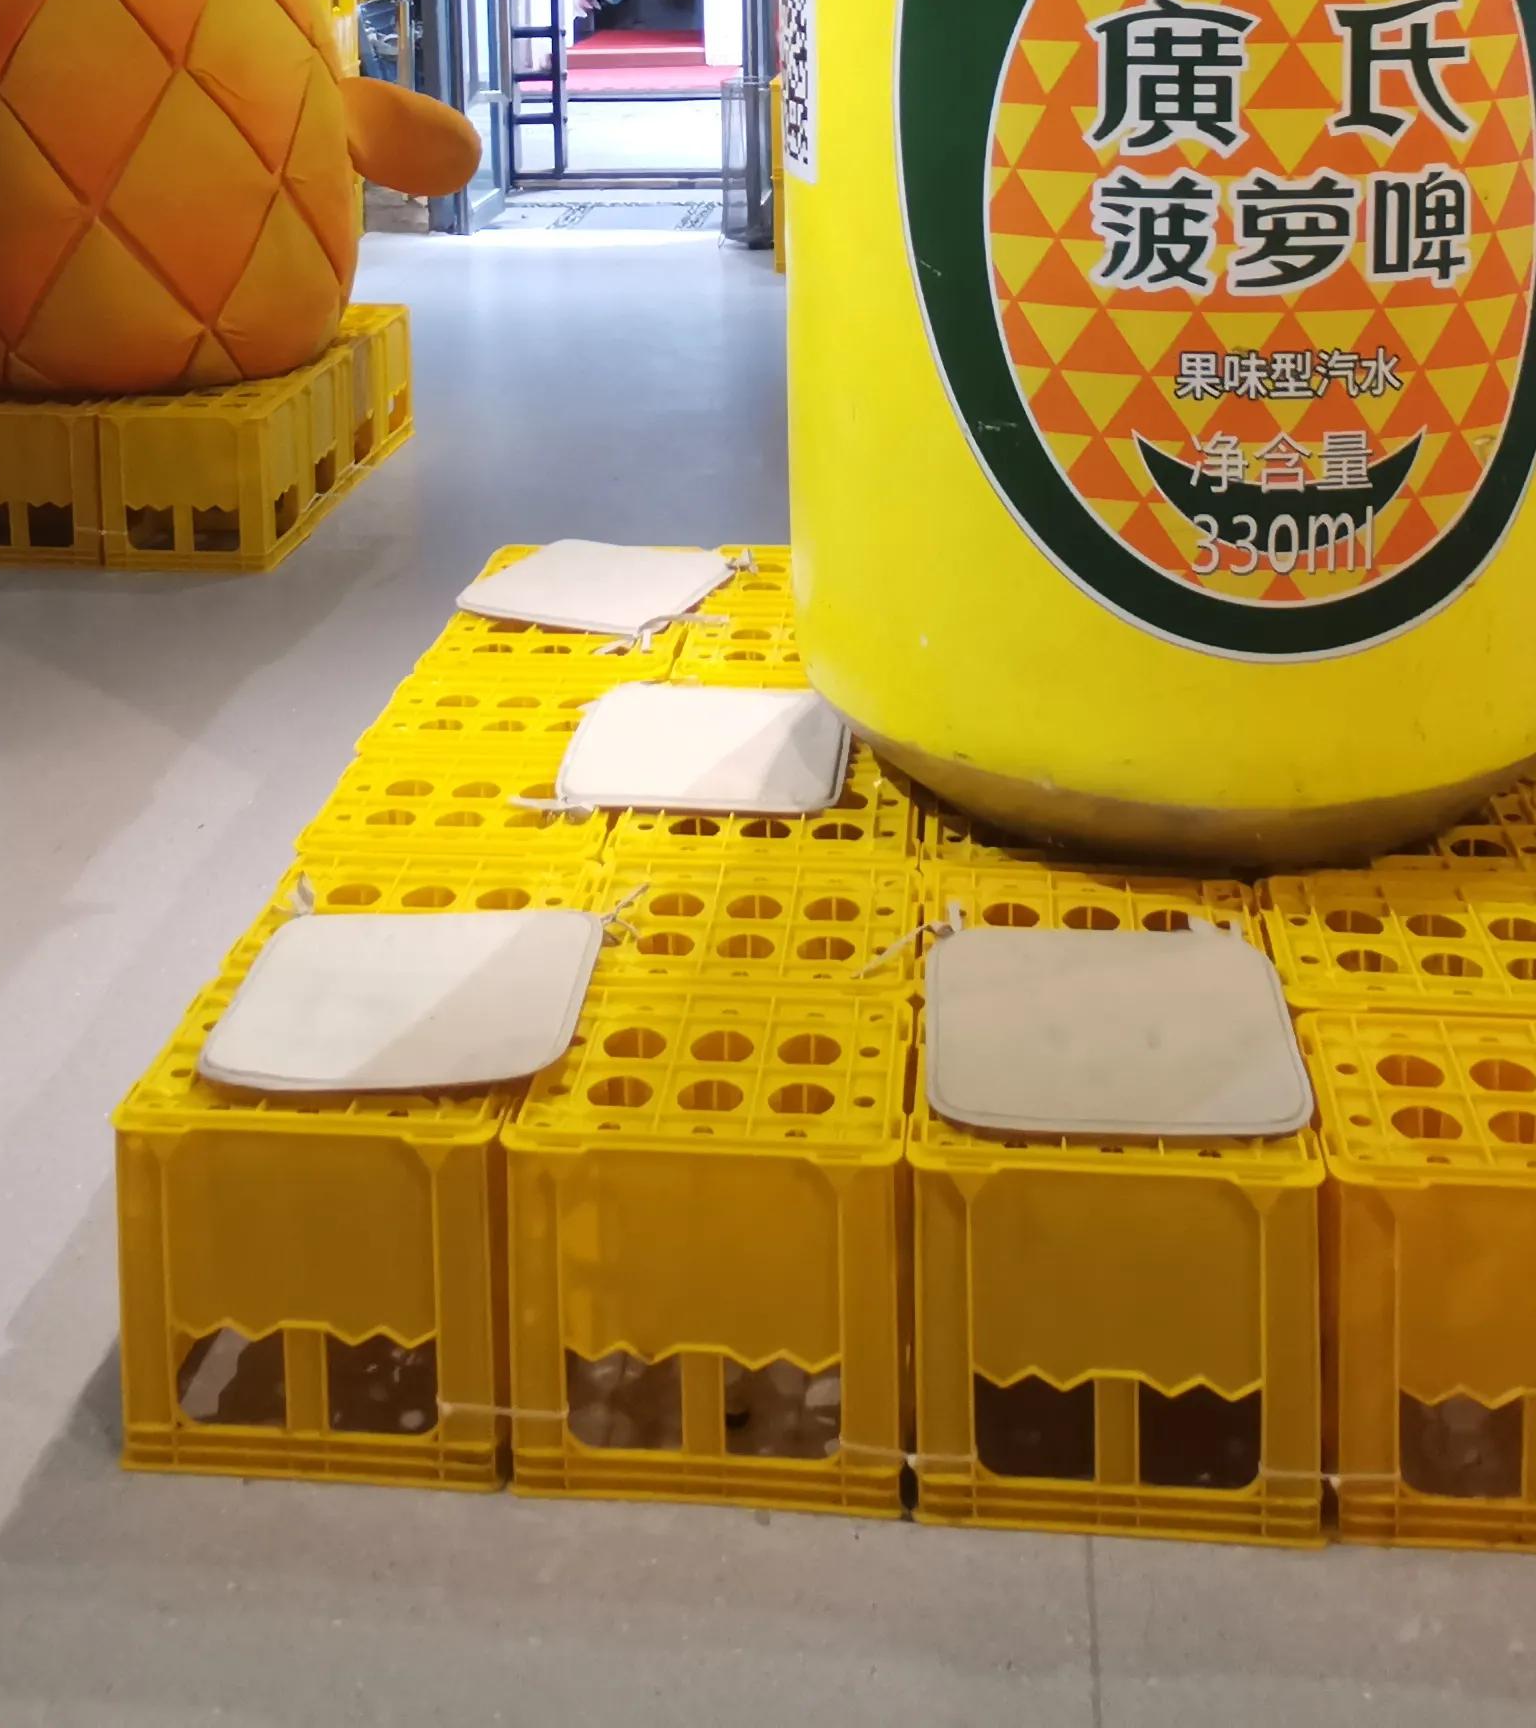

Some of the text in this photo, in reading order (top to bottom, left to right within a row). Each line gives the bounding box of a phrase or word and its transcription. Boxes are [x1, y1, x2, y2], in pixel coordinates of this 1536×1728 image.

[1098, 172, 1472, 293] 菠萝啤
[1175, 348, 1402, 401] 果味型汽水
[1189, 429, 1376, 495] 净含量
[1191, 505, 1376, 577] 330ml
